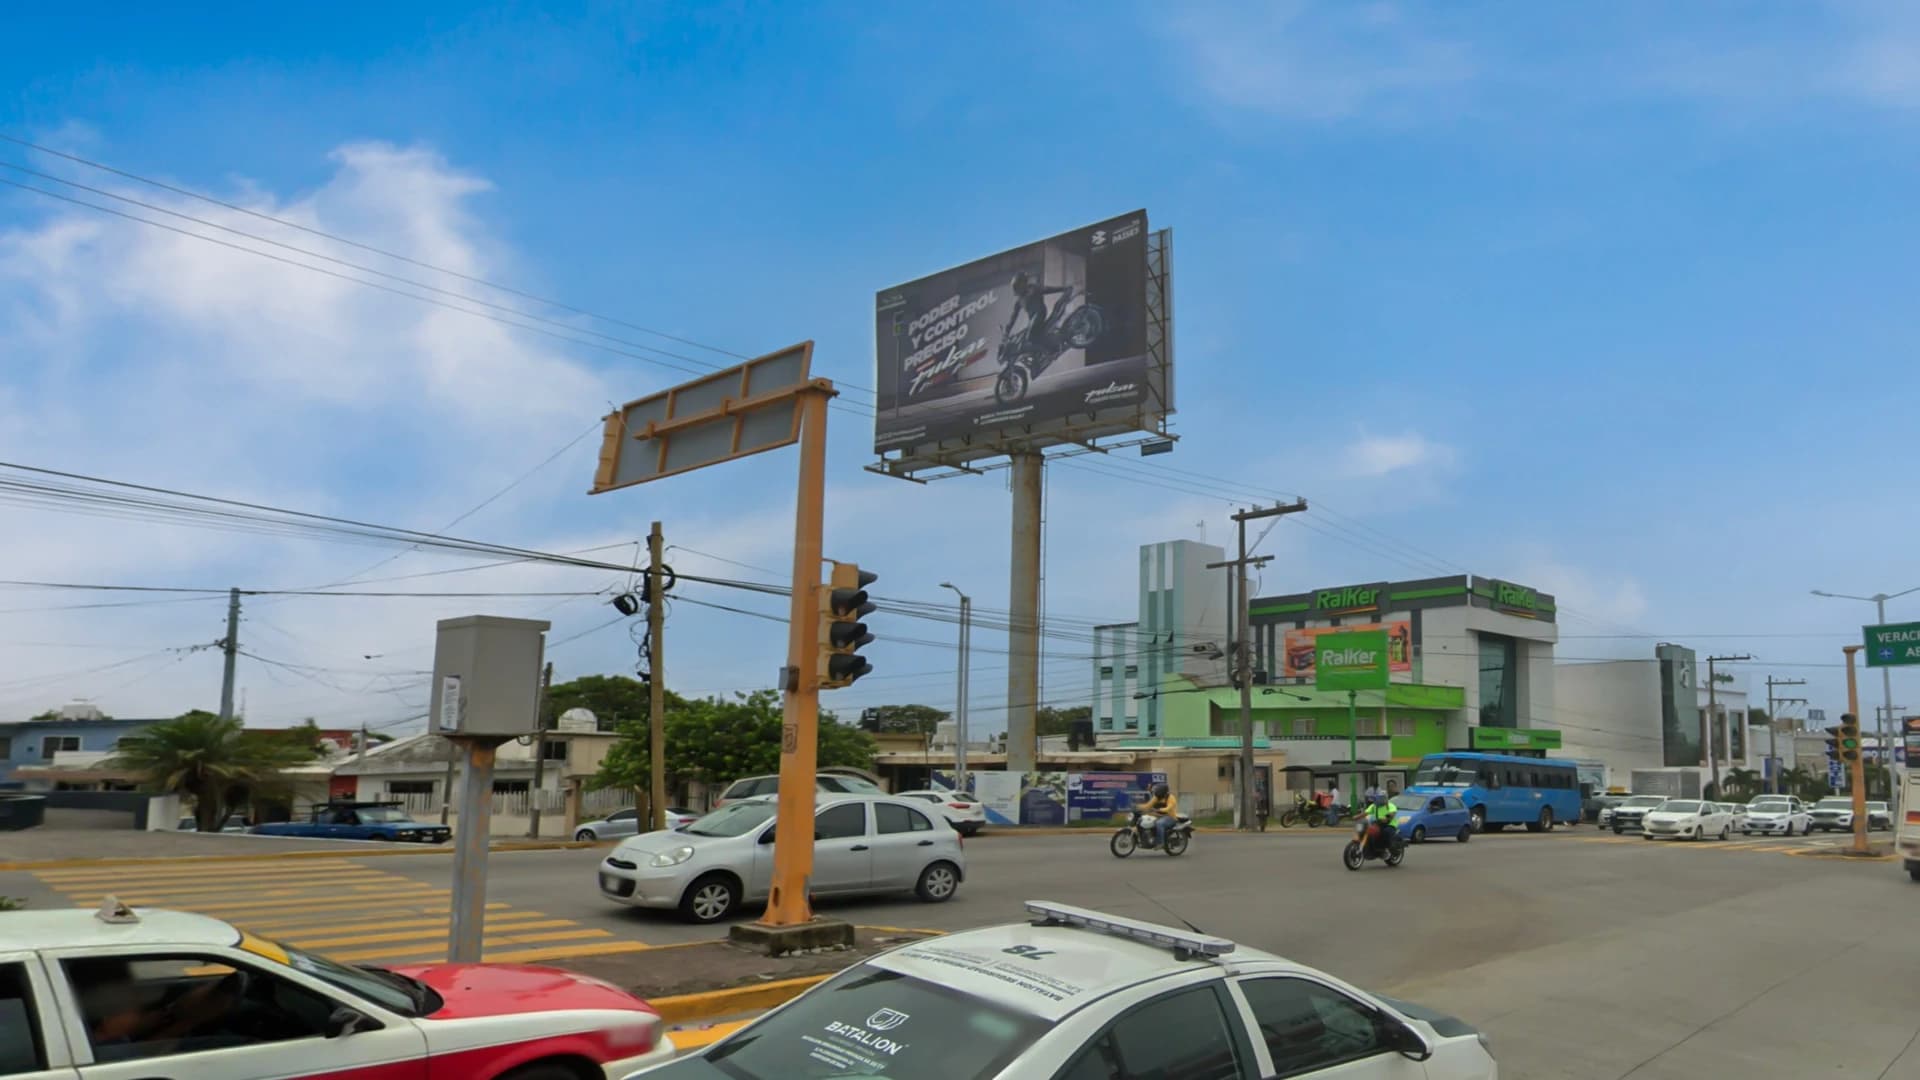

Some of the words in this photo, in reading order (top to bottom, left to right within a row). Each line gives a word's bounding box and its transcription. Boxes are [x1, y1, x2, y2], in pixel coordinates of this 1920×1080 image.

[908, 294, 961, 337] PODER
[911, 332, 922, 350] Y
[923, 290, 998, 342] CONTROL
[903, 323, 969, 372] PRECISO
[1001, 944, 1056, 960] 78
[824, 1020, 903, 1056] BATALION
